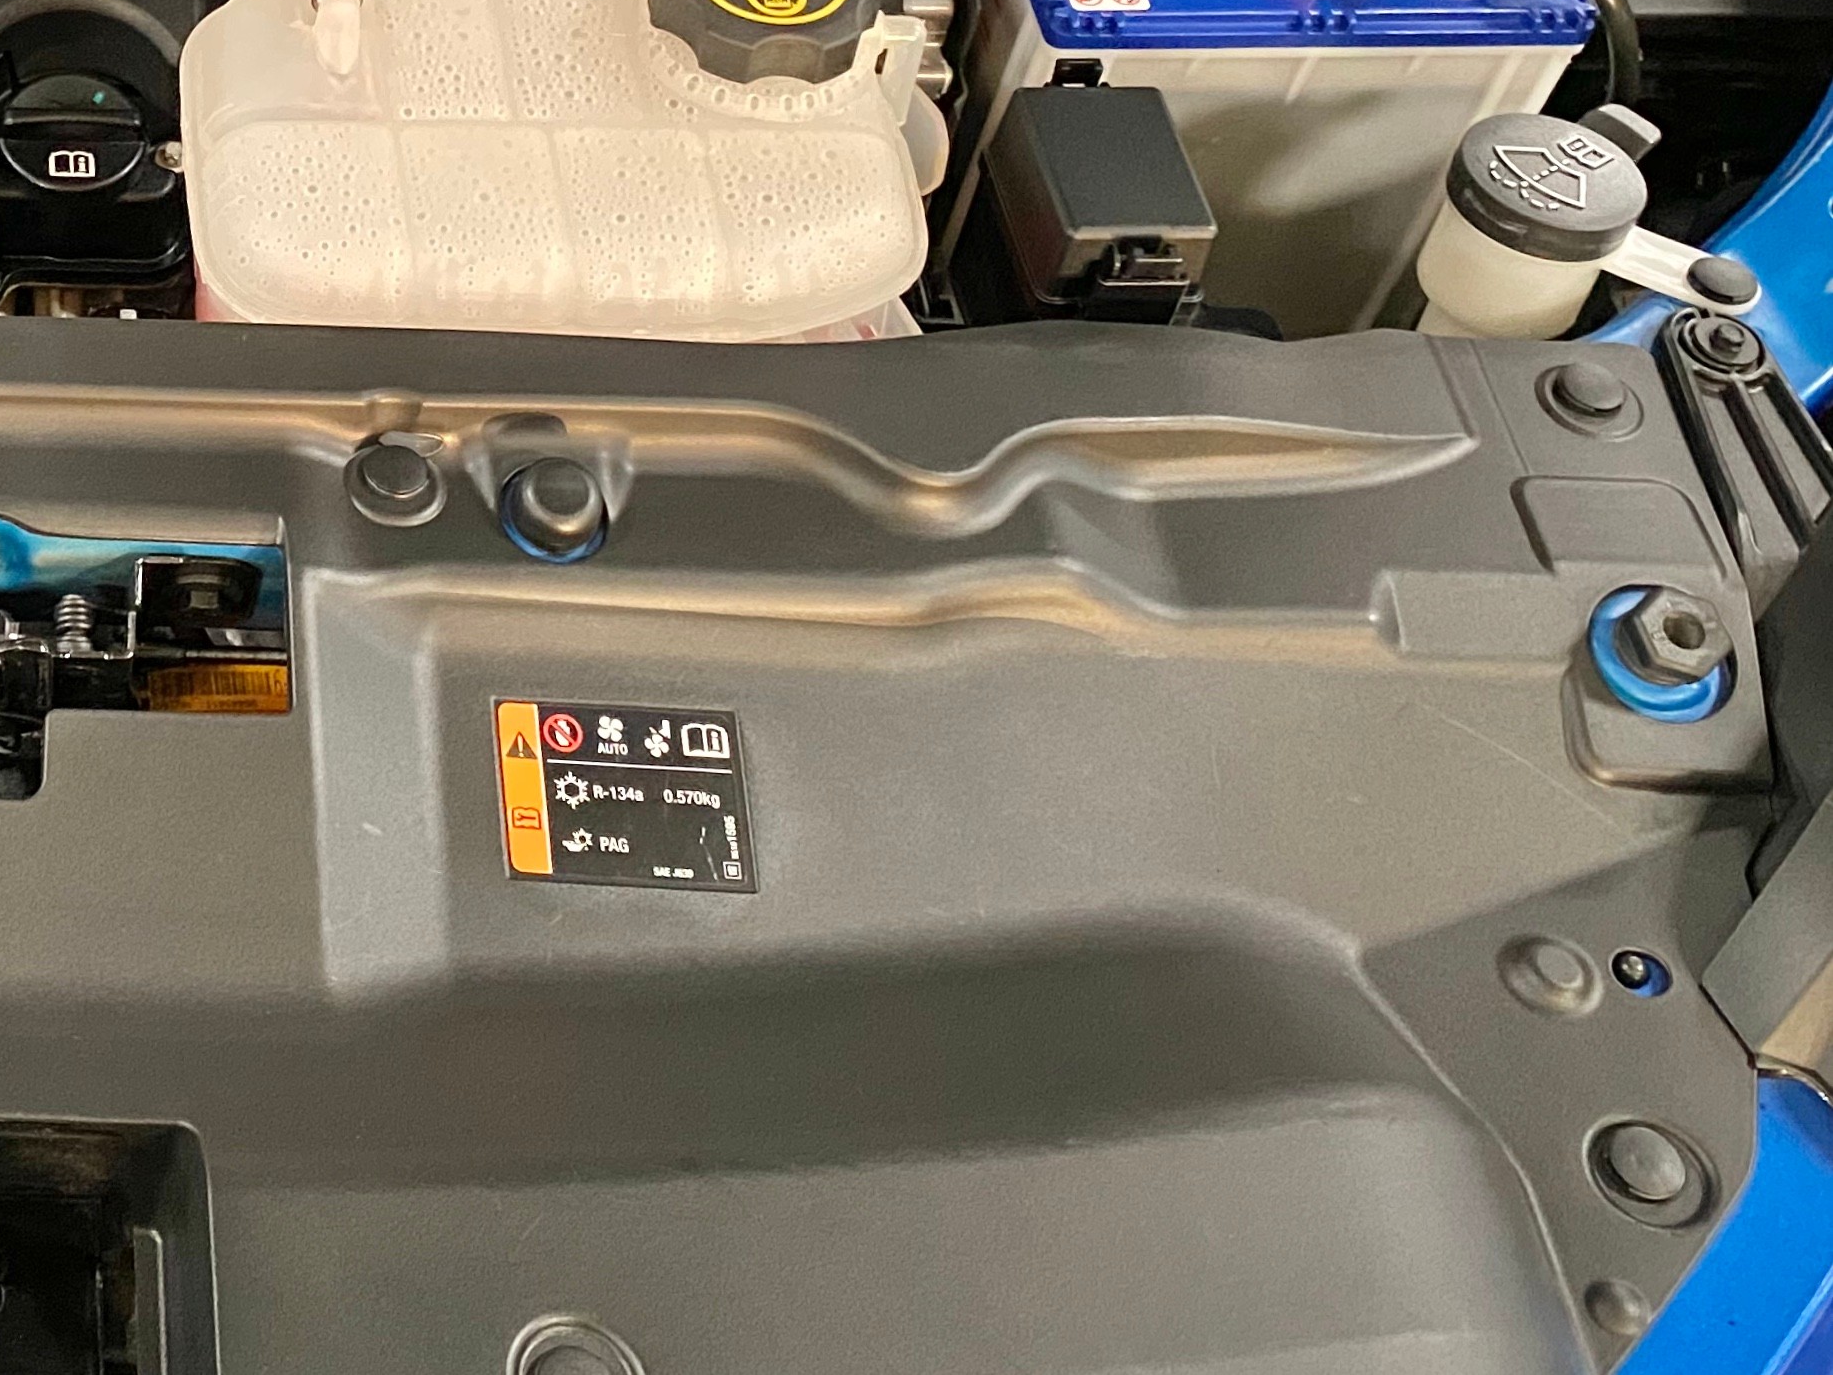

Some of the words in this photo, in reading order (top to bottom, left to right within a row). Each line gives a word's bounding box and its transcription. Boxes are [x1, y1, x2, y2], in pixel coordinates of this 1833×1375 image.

[597, 742, 629, 756] AUTO
[592, 785, 644, 802] R-134a
[663, 788, 721, 809] 0.570kg
[599, 836, 630, 853] PAG
[652, 866, 672, 877] SAE
